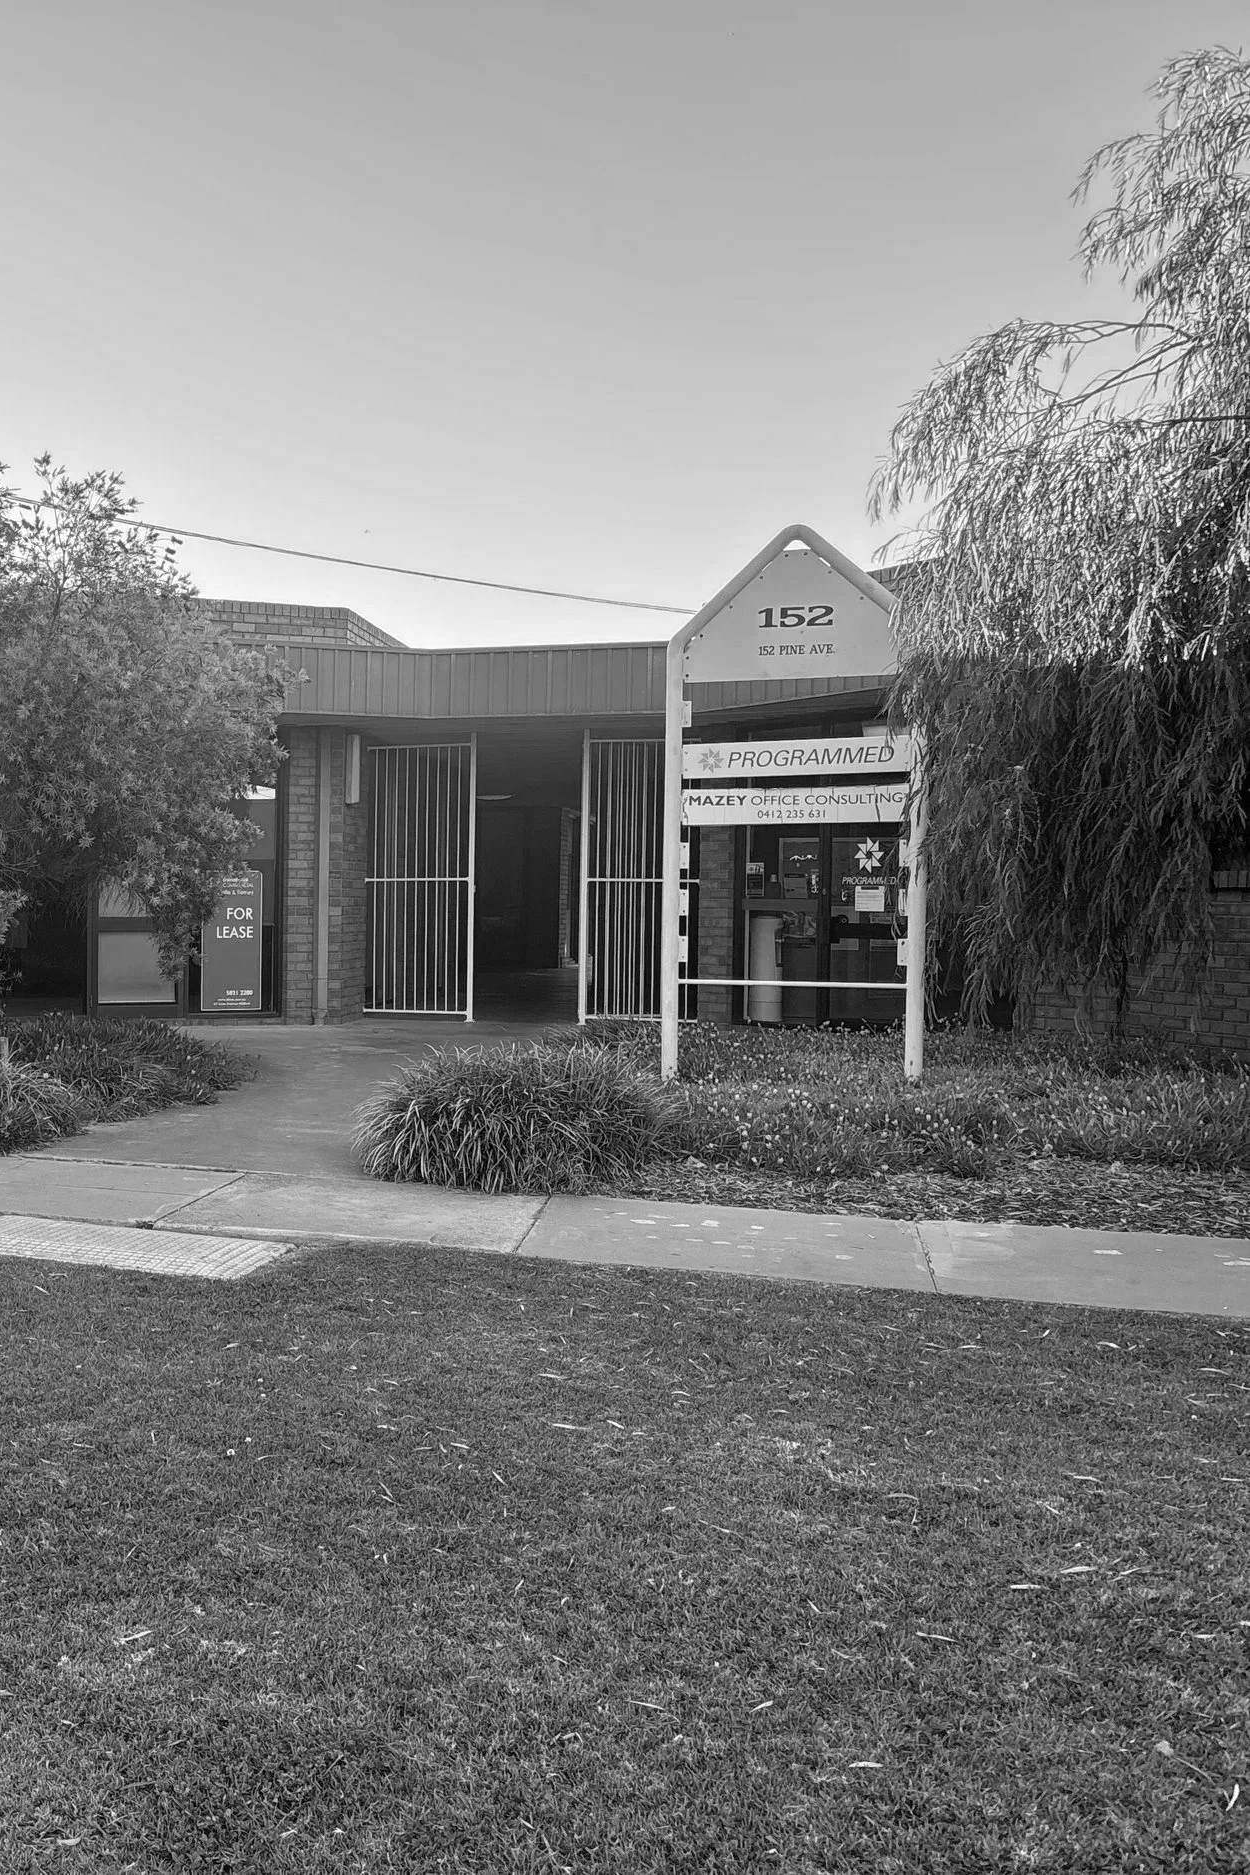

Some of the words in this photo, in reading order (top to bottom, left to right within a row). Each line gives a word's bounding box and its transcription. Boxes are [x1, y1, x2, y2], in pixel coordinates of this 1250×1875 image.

[757, 604, 835, 629] 152
[758, 645, 776, 656] 152
[778, 643, 806, 656] PINE
[809, 643, 836, 655] AVE.
[727, 745, 895, 769] PROGRAMMED
[688, 795, 747, 807] MAZEY
[750, 794, 801, 806] OFFICE
[804, 792, 904, 806] CONSULTING
[757, 809, 783, 819] 0412
[785, 809, 805, 819] 235
[808, 808, 827, 818] 631
[226, 907, 254, 920] FOR
[216, 926, 254, 939] LEASE
